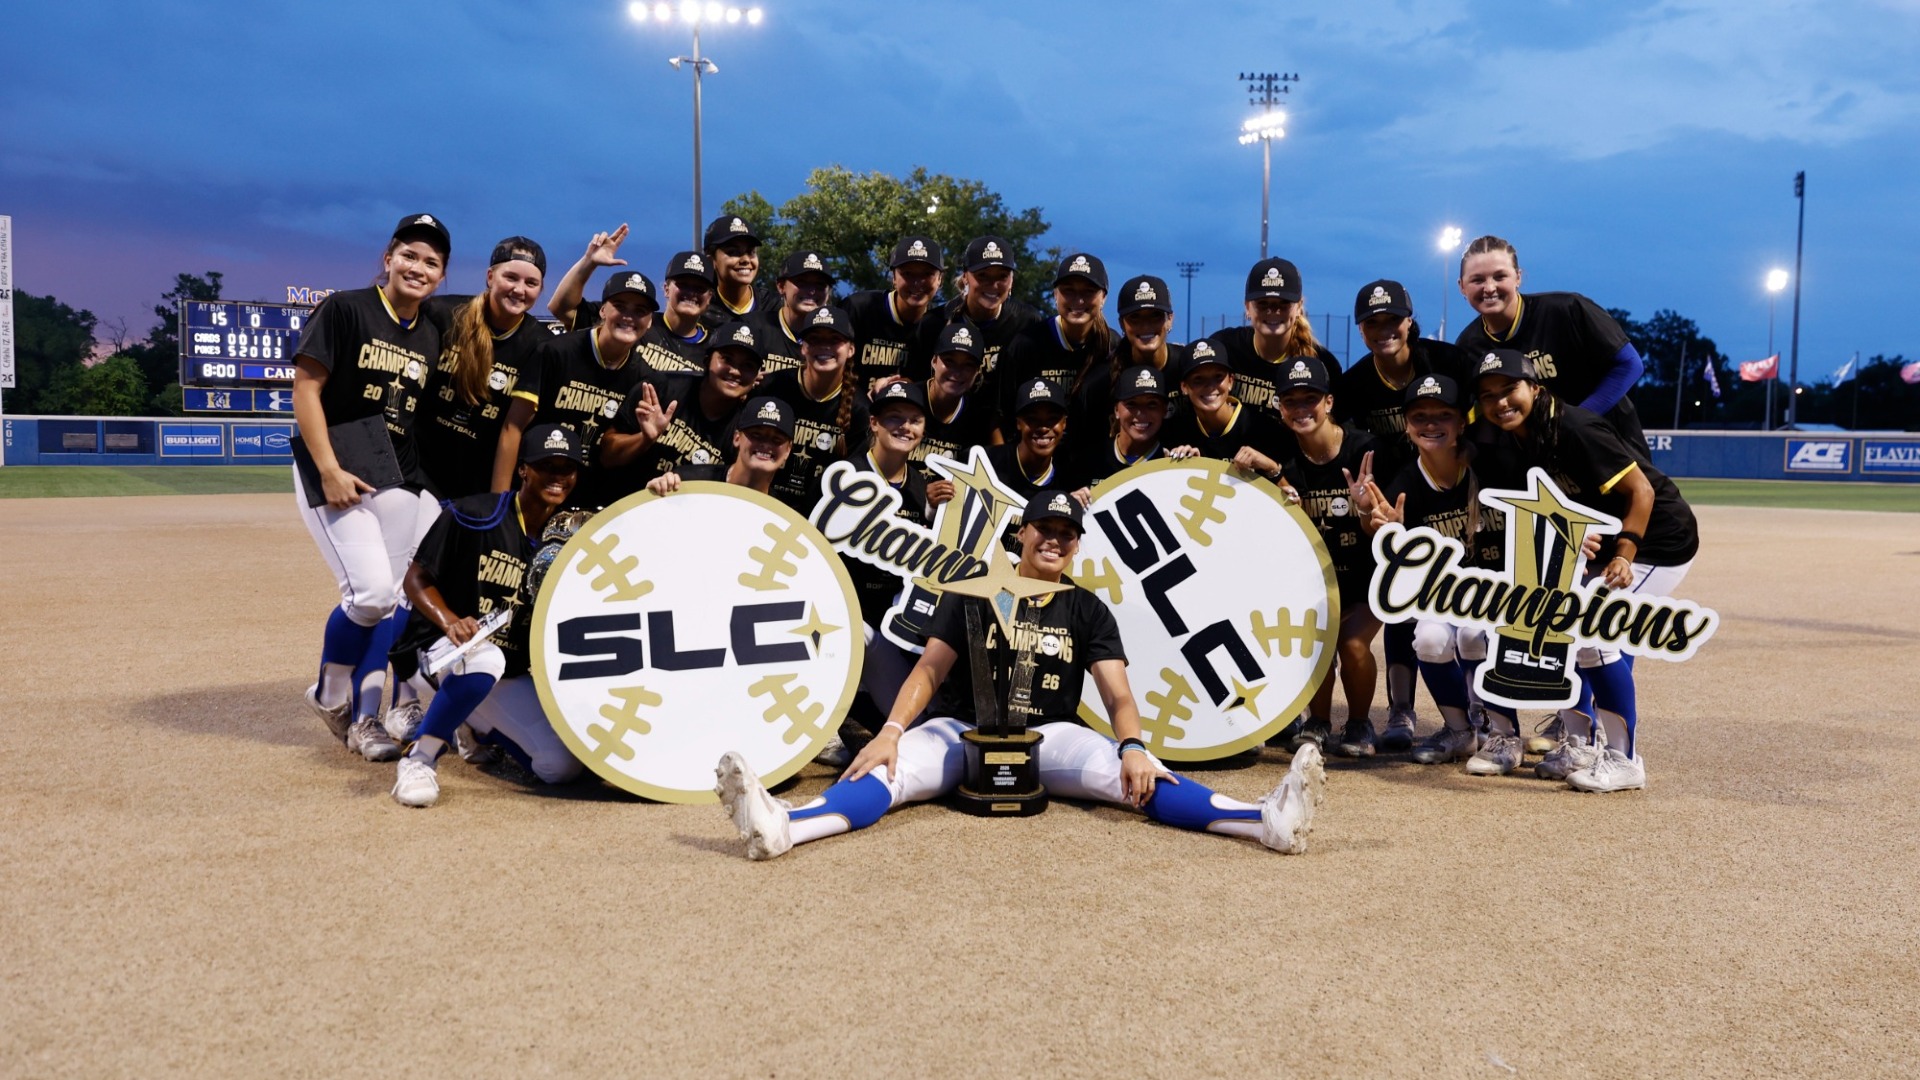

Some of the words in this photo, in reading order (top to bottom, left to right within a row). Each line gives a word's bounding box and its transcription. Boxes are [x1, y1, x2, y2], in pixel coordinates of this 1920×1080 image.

[210, 304, 226, 312] BAT
[245, 306, 265, 315] BALL
[212, 312, 228, 326] 15
[250, 313, 261, 328] 0
[290, 316, 300, 330] 0
[228, 333, 236, 345] 0
[239, 333, 248, 346] 0
[253, 335, 258, 346] 1
[262, 335, 271, 347] 0
[277, 336, 282, 347] 1
[872, 337, 907, 349] SOUTH
[228, 345, 237, 357] 5
[239, 346, 248, 358] 2
[250, 346, 258, 358] 0
[262, 347, 271, 358] 0
[274, 347, 282, 359] 3
[371, 338, 426, 362] SOUTHLAND
[861, 344, 909, 367] CHAMPI
[203, 363, 236, 378] 8:00
[264, 367, 296, 379] CAR
[1234, 373, 1276, 389] SOUTHL
[363, 383, 383, 401] 20
[481, 403, 500, 420] 26
[386, 422, 405, 435] BALL
[436, 416, 477, 440] SOFTBALL
[166, 436, 189, 444] BUD
[189, 436, 218, 444] LIGHT
[1791, 442, 1847, 463] ACE
[1340, 532, 1357, 547] 26
[1481, 545, 1500, 561] 26
[1093, 488, 1266, 708] SLC
[1378, 529, 1709, 660] Champions
[557, 600, 811, 681] SLC
[985, 623, 1073, 664] CAMPIONS
[1502, 650, 1547, 670] SLC
[1042, 673, 1061, 691] 26
[1007, 704, 1044, 716] FTBALL
